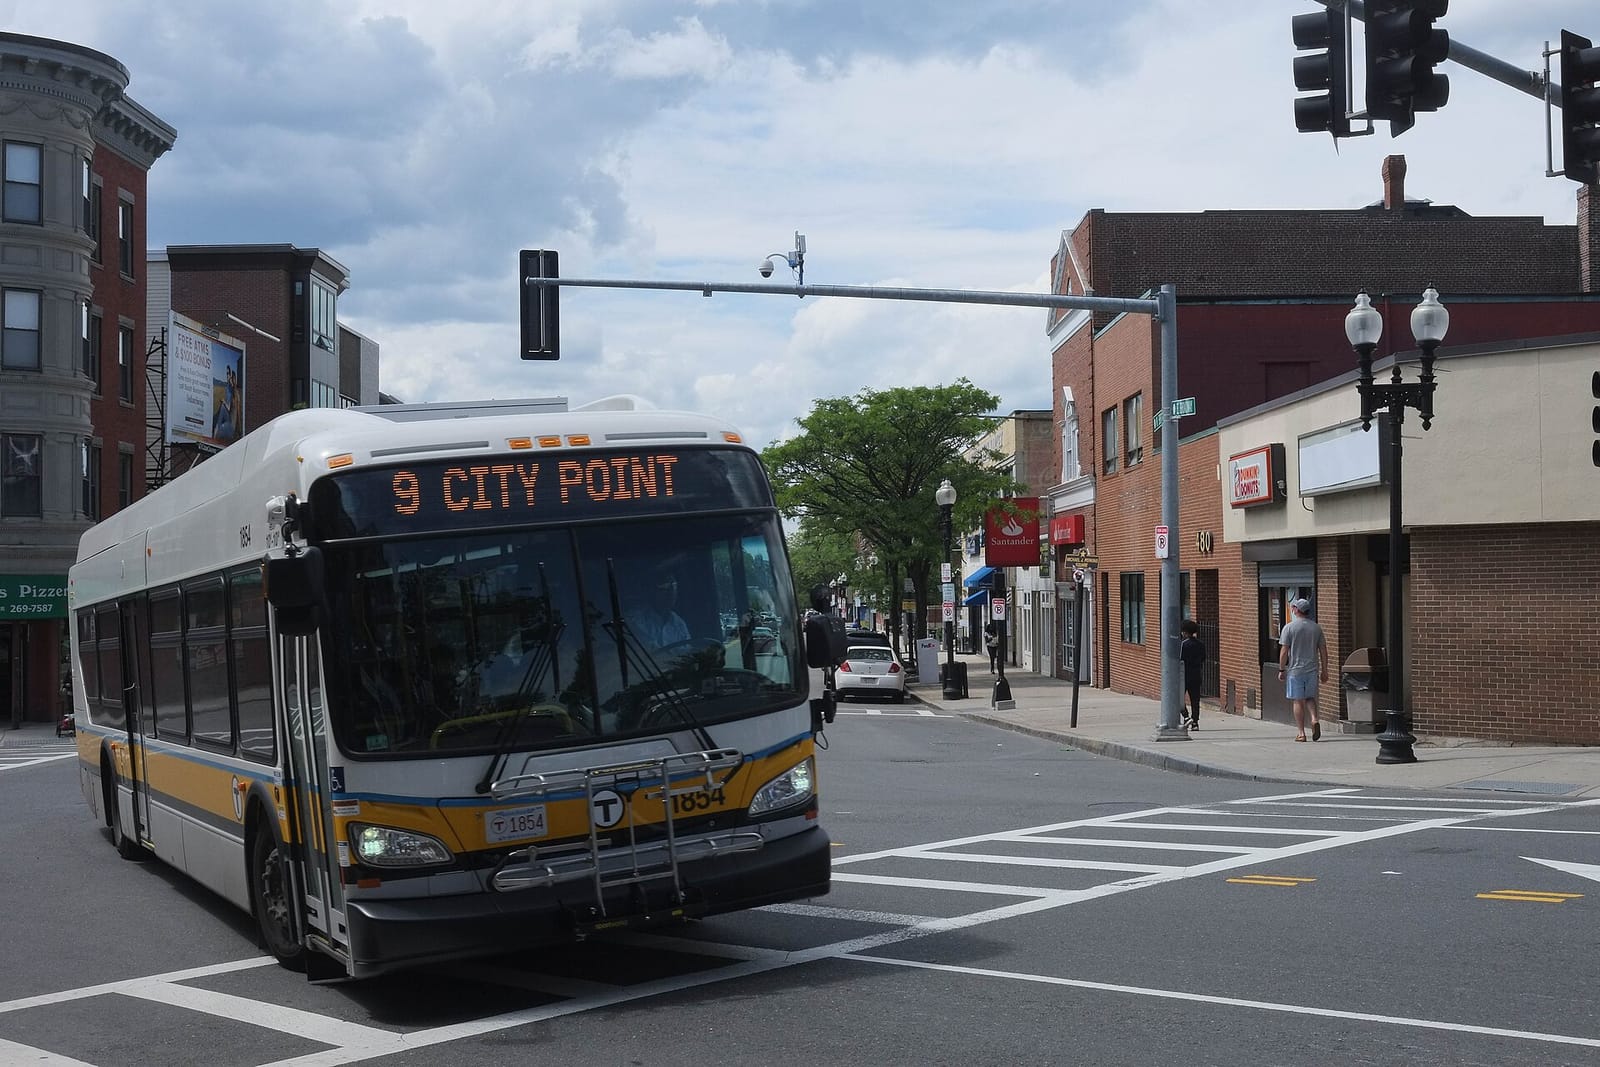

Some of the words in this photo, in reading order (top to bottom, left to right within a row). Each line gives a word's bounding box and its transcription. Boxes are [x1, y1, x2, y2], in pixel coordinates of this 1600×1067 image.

[392, 471, 420, 515] 9
[442, 463, 540, 511] CITY
[558, 455, 678, 504] POINT
[991, 536, 1035, 546] Santander
[10, 604, 53, 613] 269-7587
[594, 798, 617, 822] T
[670, 788, 726, 814] 1854
[510, 813, 544, 833] 1854
